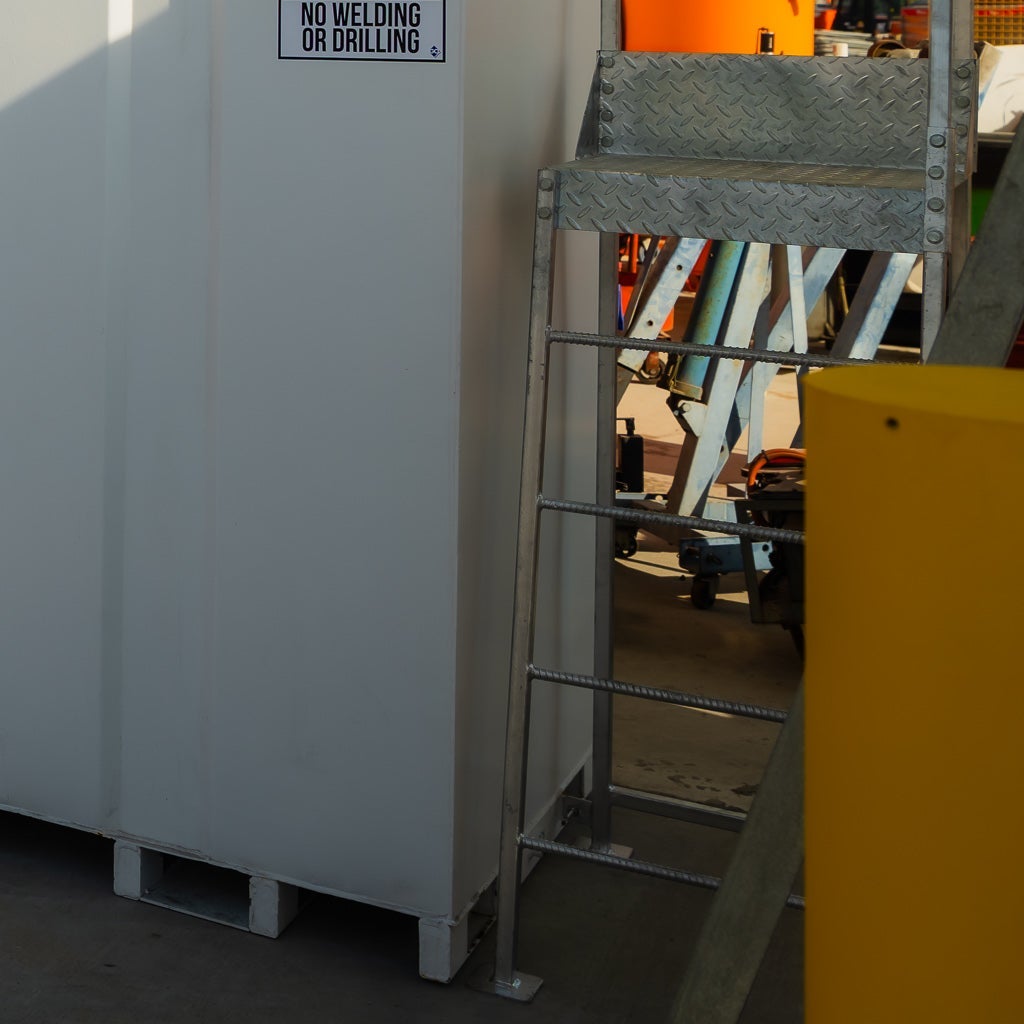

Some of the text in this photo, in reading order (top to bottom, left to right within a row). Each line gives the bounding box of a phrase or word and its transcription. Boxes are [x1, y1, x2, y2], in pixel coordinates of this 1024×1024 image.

[301, 2, 421, 27] NO WELDING
[302, 28, 420, 54] OR DRILLING
